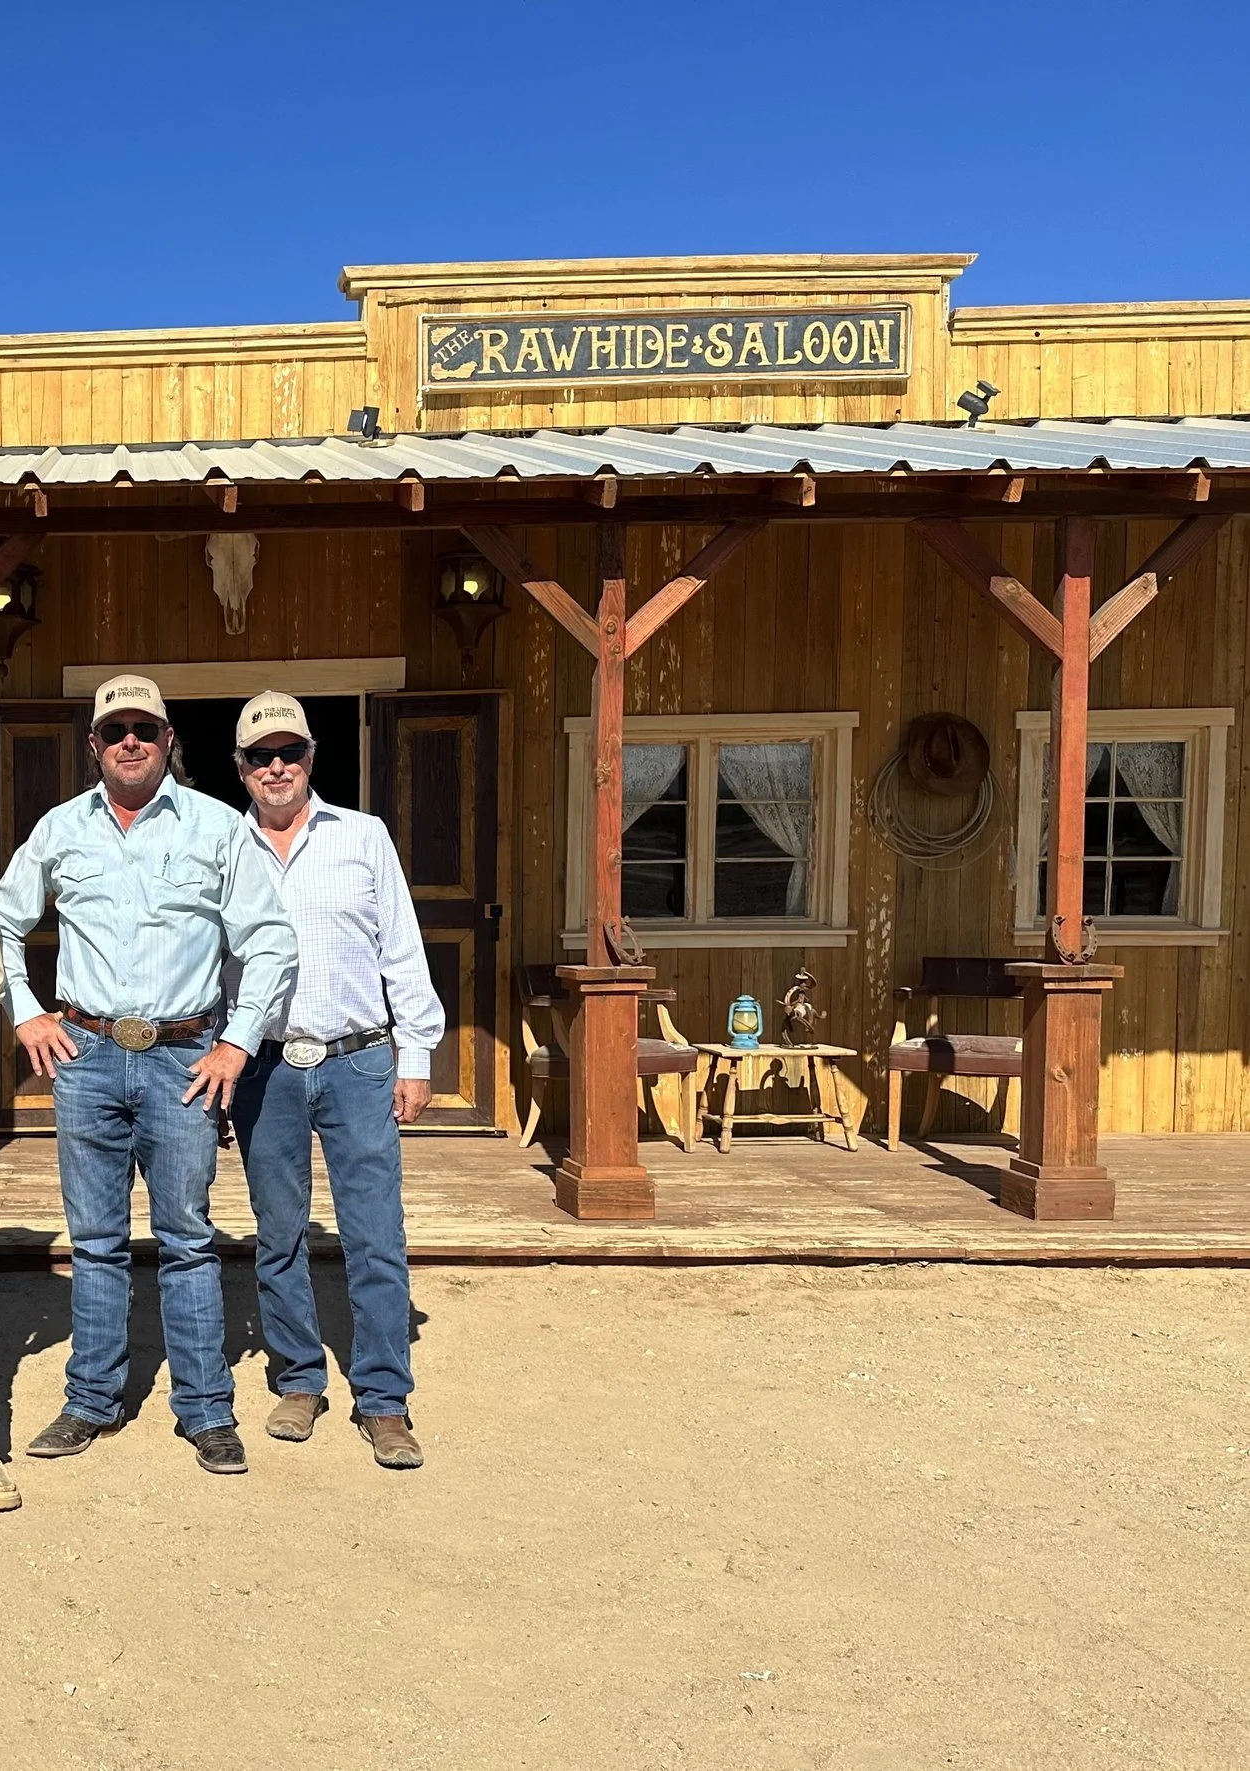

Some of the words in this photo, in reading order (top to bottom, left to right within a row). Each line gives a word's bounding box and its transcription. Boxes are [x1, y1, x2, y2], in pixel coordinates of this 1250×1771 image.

[434, 329, 474, 363] THE
[473, 323, 690, 374] RAWHIDE
[704, 319, 895, 368] SALOON
